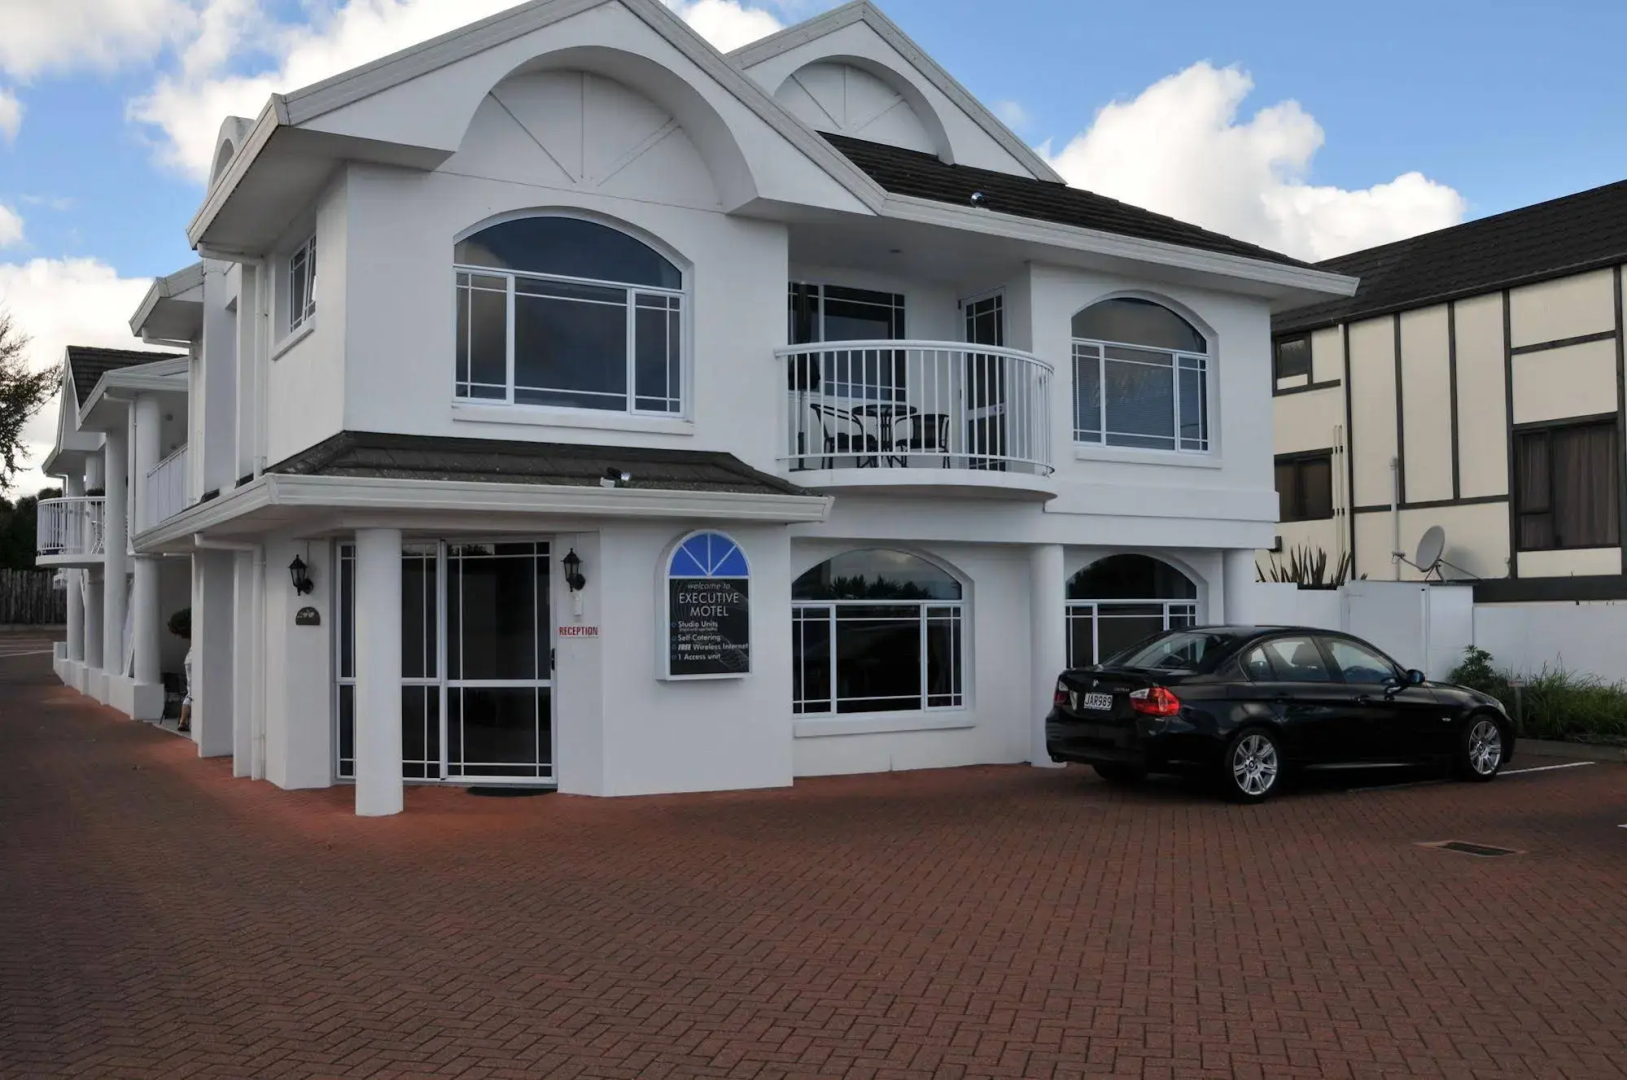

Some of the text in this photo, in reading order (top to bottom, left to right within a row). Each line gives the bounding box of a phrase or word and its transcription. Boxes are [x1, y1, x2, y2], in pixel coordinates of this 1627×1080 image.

[688, 582, 731, 590] welcome to
[679, 592, 739, 604] EXECUTIVE
[690, 605, 729, 617] MOTEL
[701, 620, 718, 628] Units
[559, 626, 598, 636] RECEPTION
[692, 634, 720, 642] Catering
[693, 643, 720, 651] Wireless
[1085, 695, 1111, 707] JAR989
